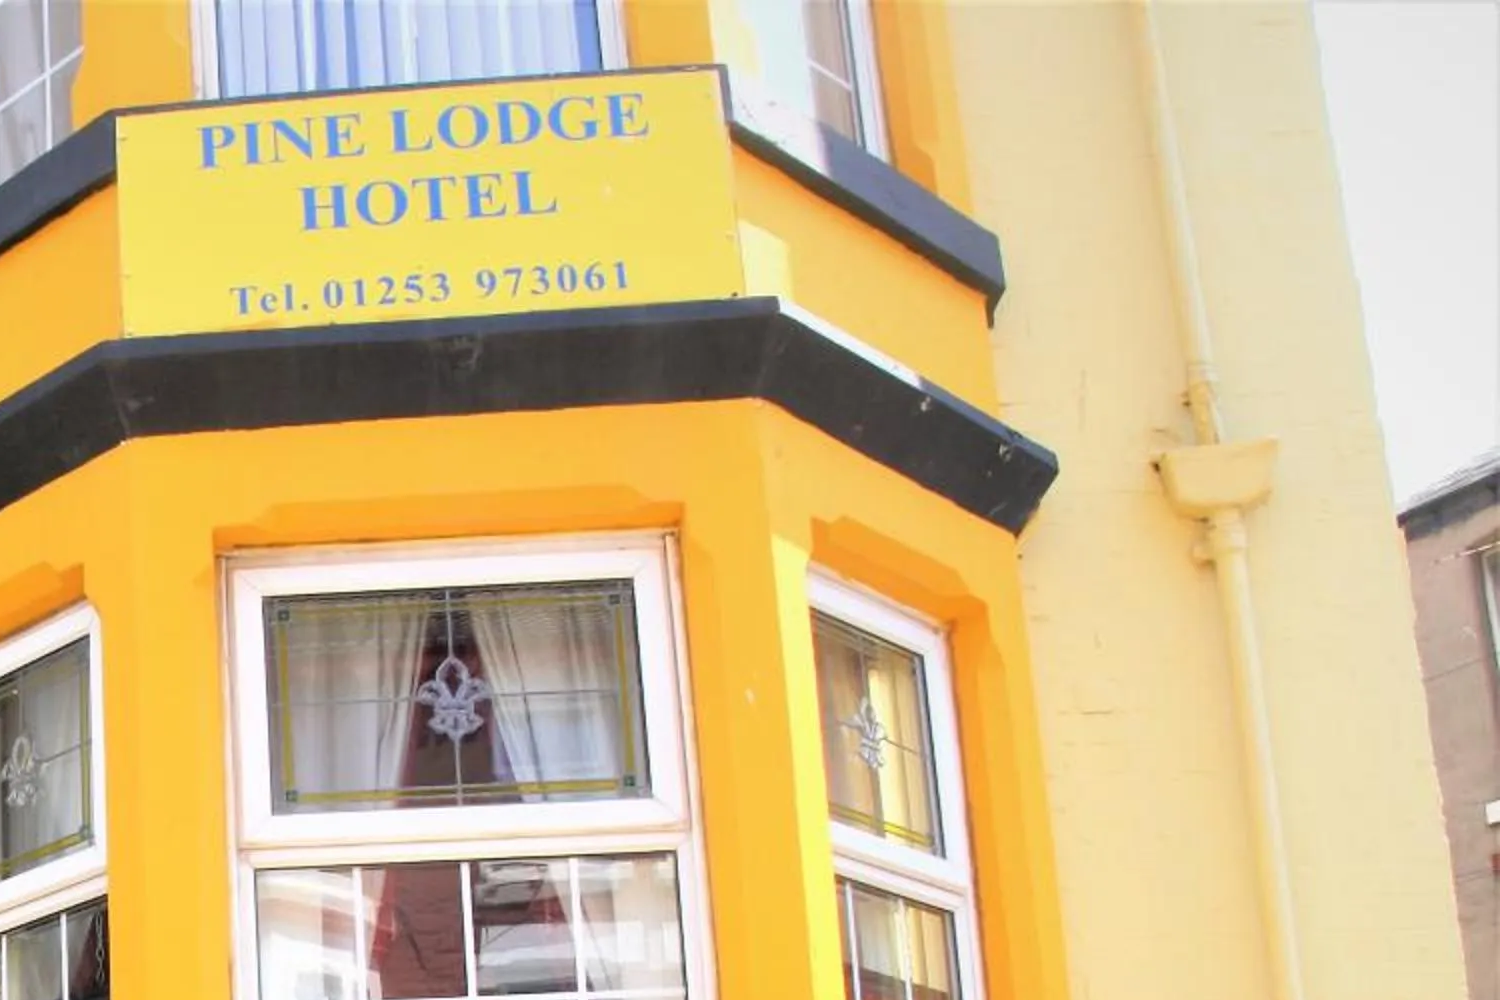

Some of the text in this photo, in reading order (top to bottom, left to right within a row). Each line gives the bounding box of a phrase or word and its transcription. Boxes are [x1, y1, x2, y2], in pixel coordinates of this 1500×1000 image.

[196, 92, 651, 169] PINE LODGE
[299, 170, 558, 231] HOTEL
[229, 260, 630, 316] Tel. 01253 973061
